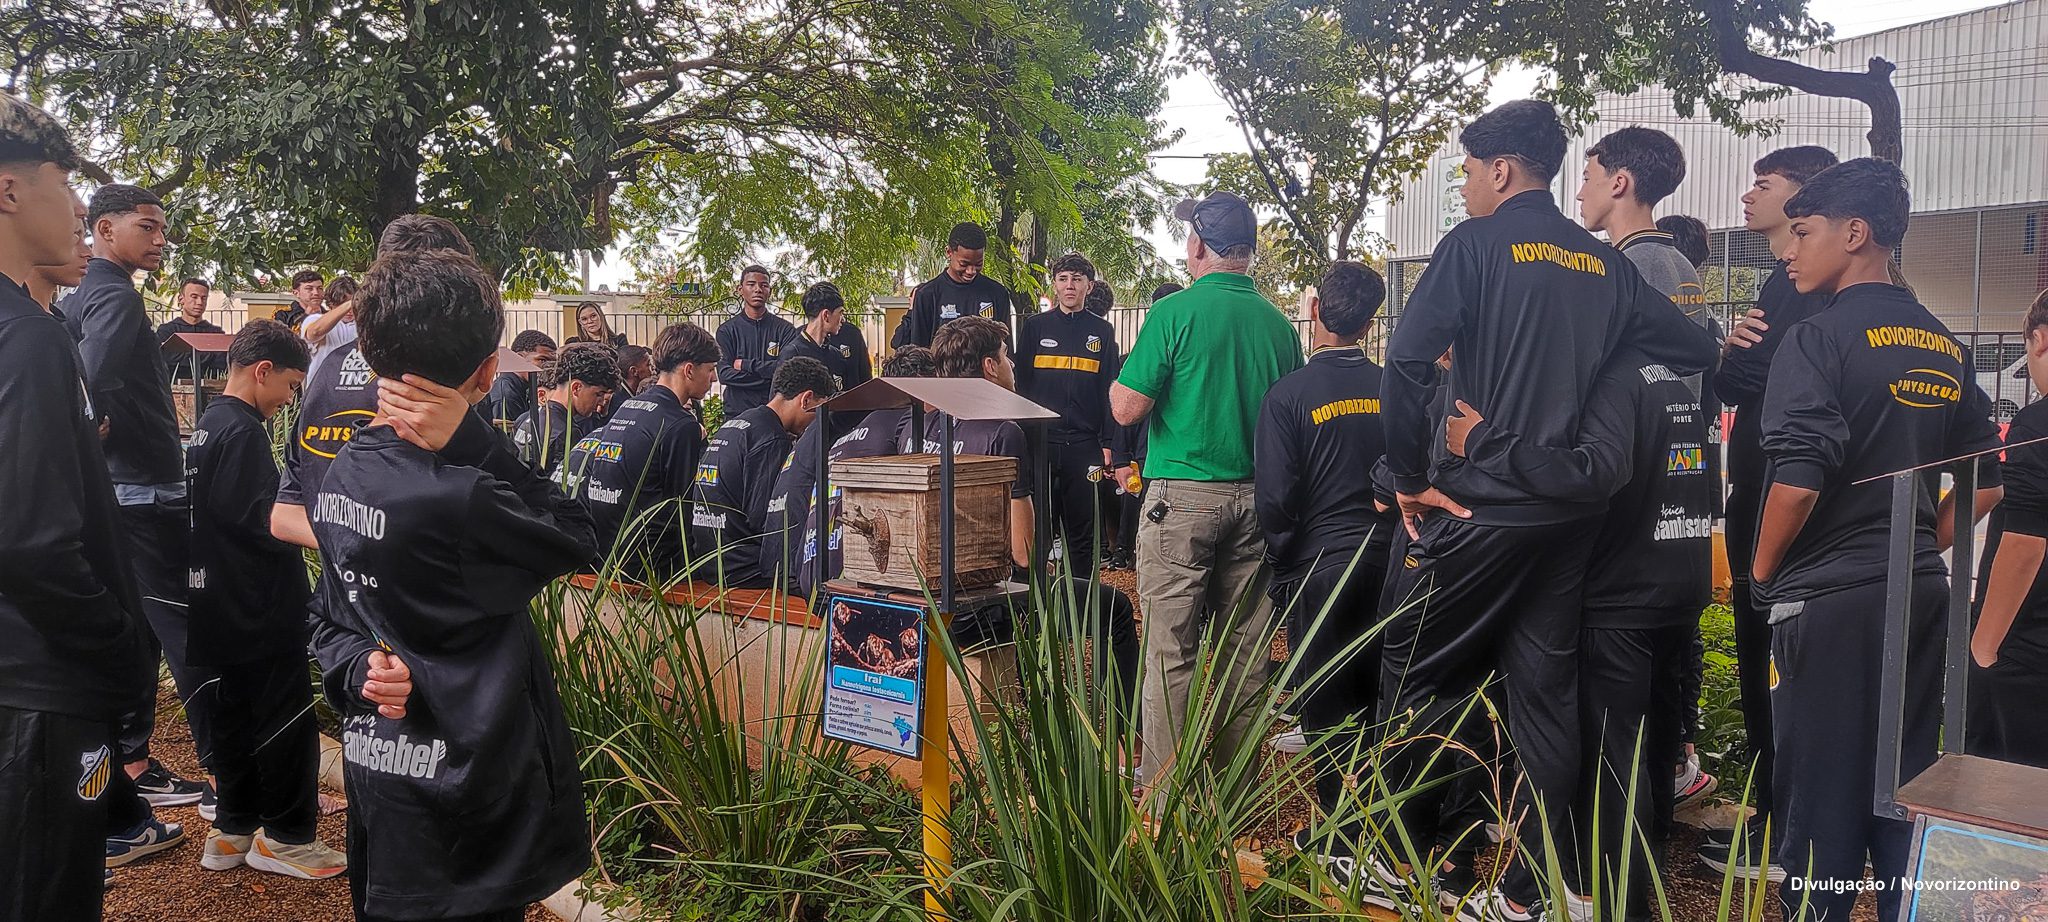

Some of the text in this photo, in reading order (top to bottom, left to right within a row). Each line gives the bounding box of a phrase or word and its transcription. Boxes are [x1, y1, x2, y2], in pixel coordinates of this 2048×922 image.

[1511, 242, 1607, 277] NOVORIZONTINO
[1866, 325, 1964, 365] NOVORIZONTINO
[339, 371, 370, 386] TINO
[1896, 378, 1959, 402] PHYSICUS
[1311, 398, 1380, 426] NOVORIZON
[305, 425, 352, 442] PHYS
[361, 573, 378, 588] DO
